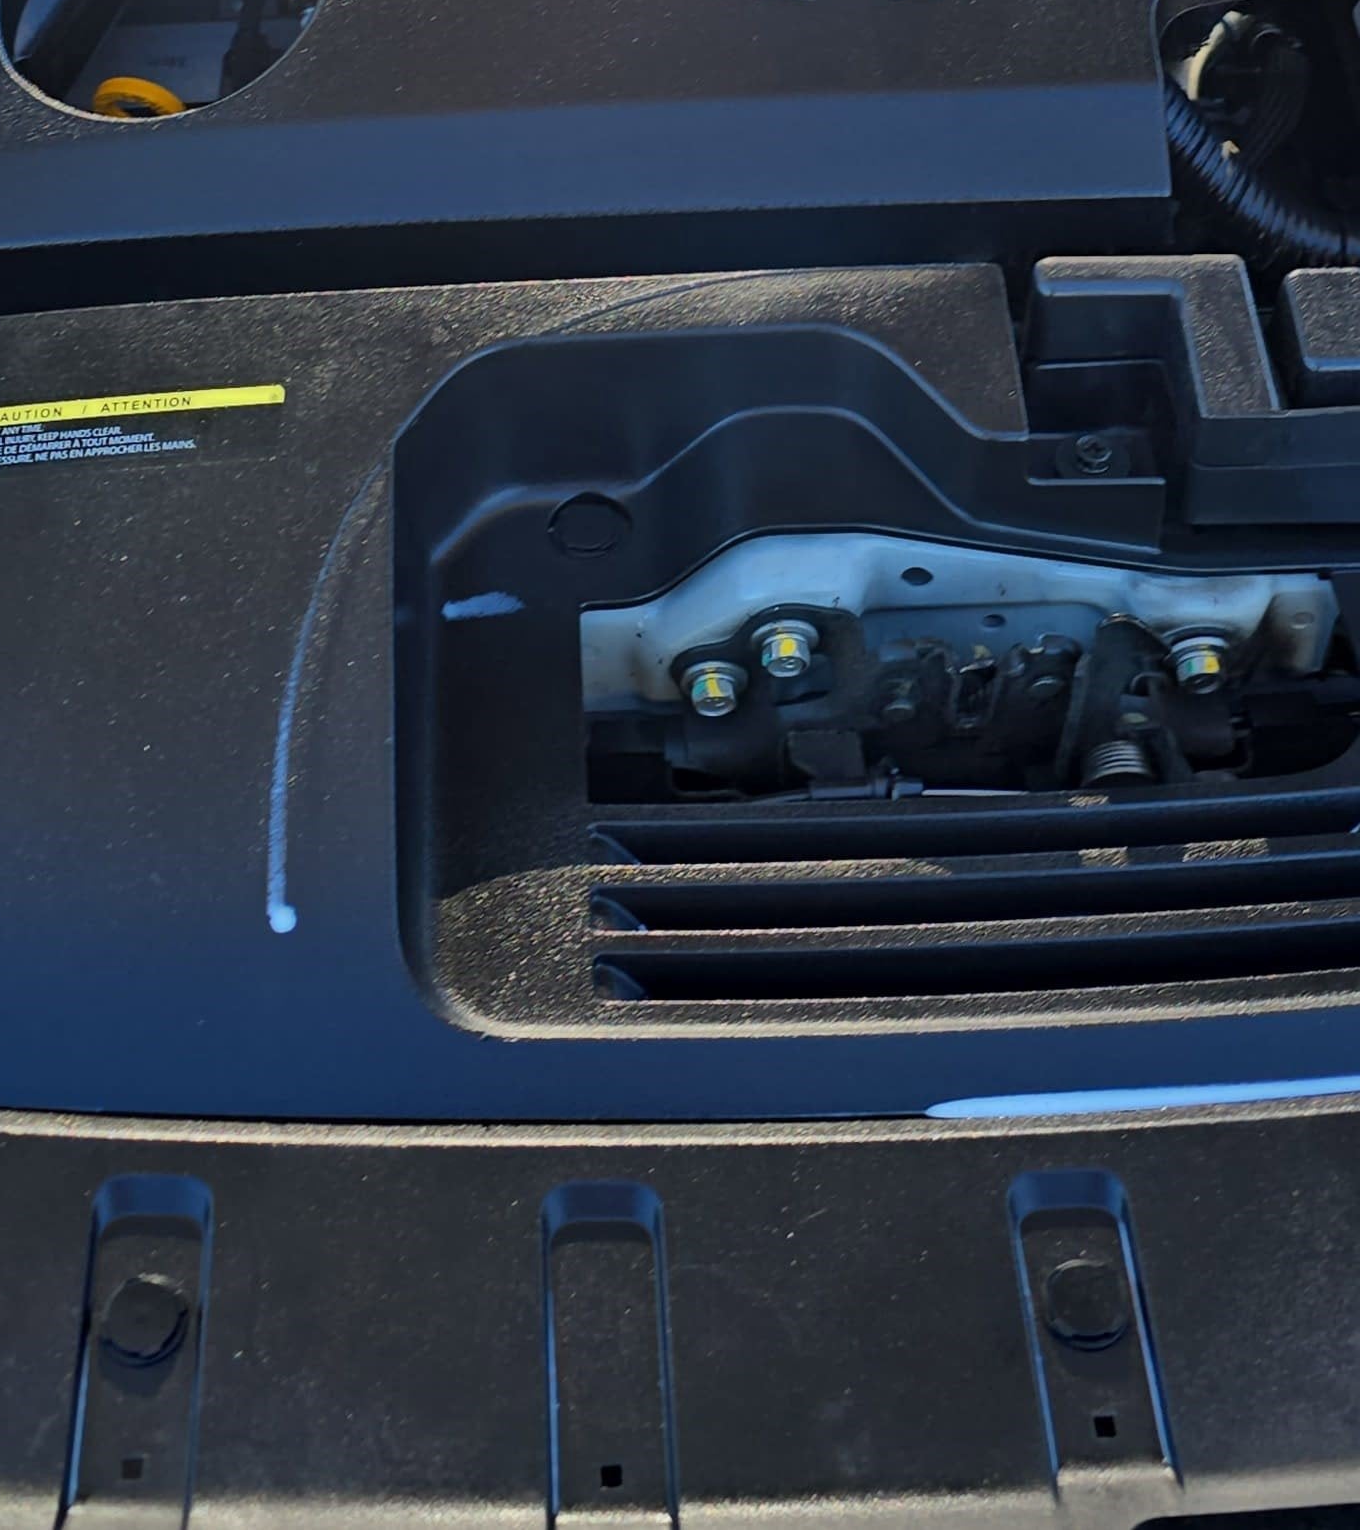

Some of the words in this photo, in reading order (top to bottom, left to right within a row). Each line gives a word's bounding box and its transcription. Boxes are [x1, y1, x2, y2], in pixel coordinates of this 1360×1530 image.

[100, 396, 192, 413] ATTENTION
[1, 425, 20, 435] ANY
[37, 432, 59, 442] KEEP
[60, 428, 92, 439] HANDS
[4, 445, 17, 455] DE
[82, 436, 108, 447] TOUT
[35, 452, 48, 462] NE
[50, 449, 68, 460] PAS
[69, 448, 84, 458] EN
[84, 444, 143, 458] APPROCHER
[144, 442, 161, 452] LES
